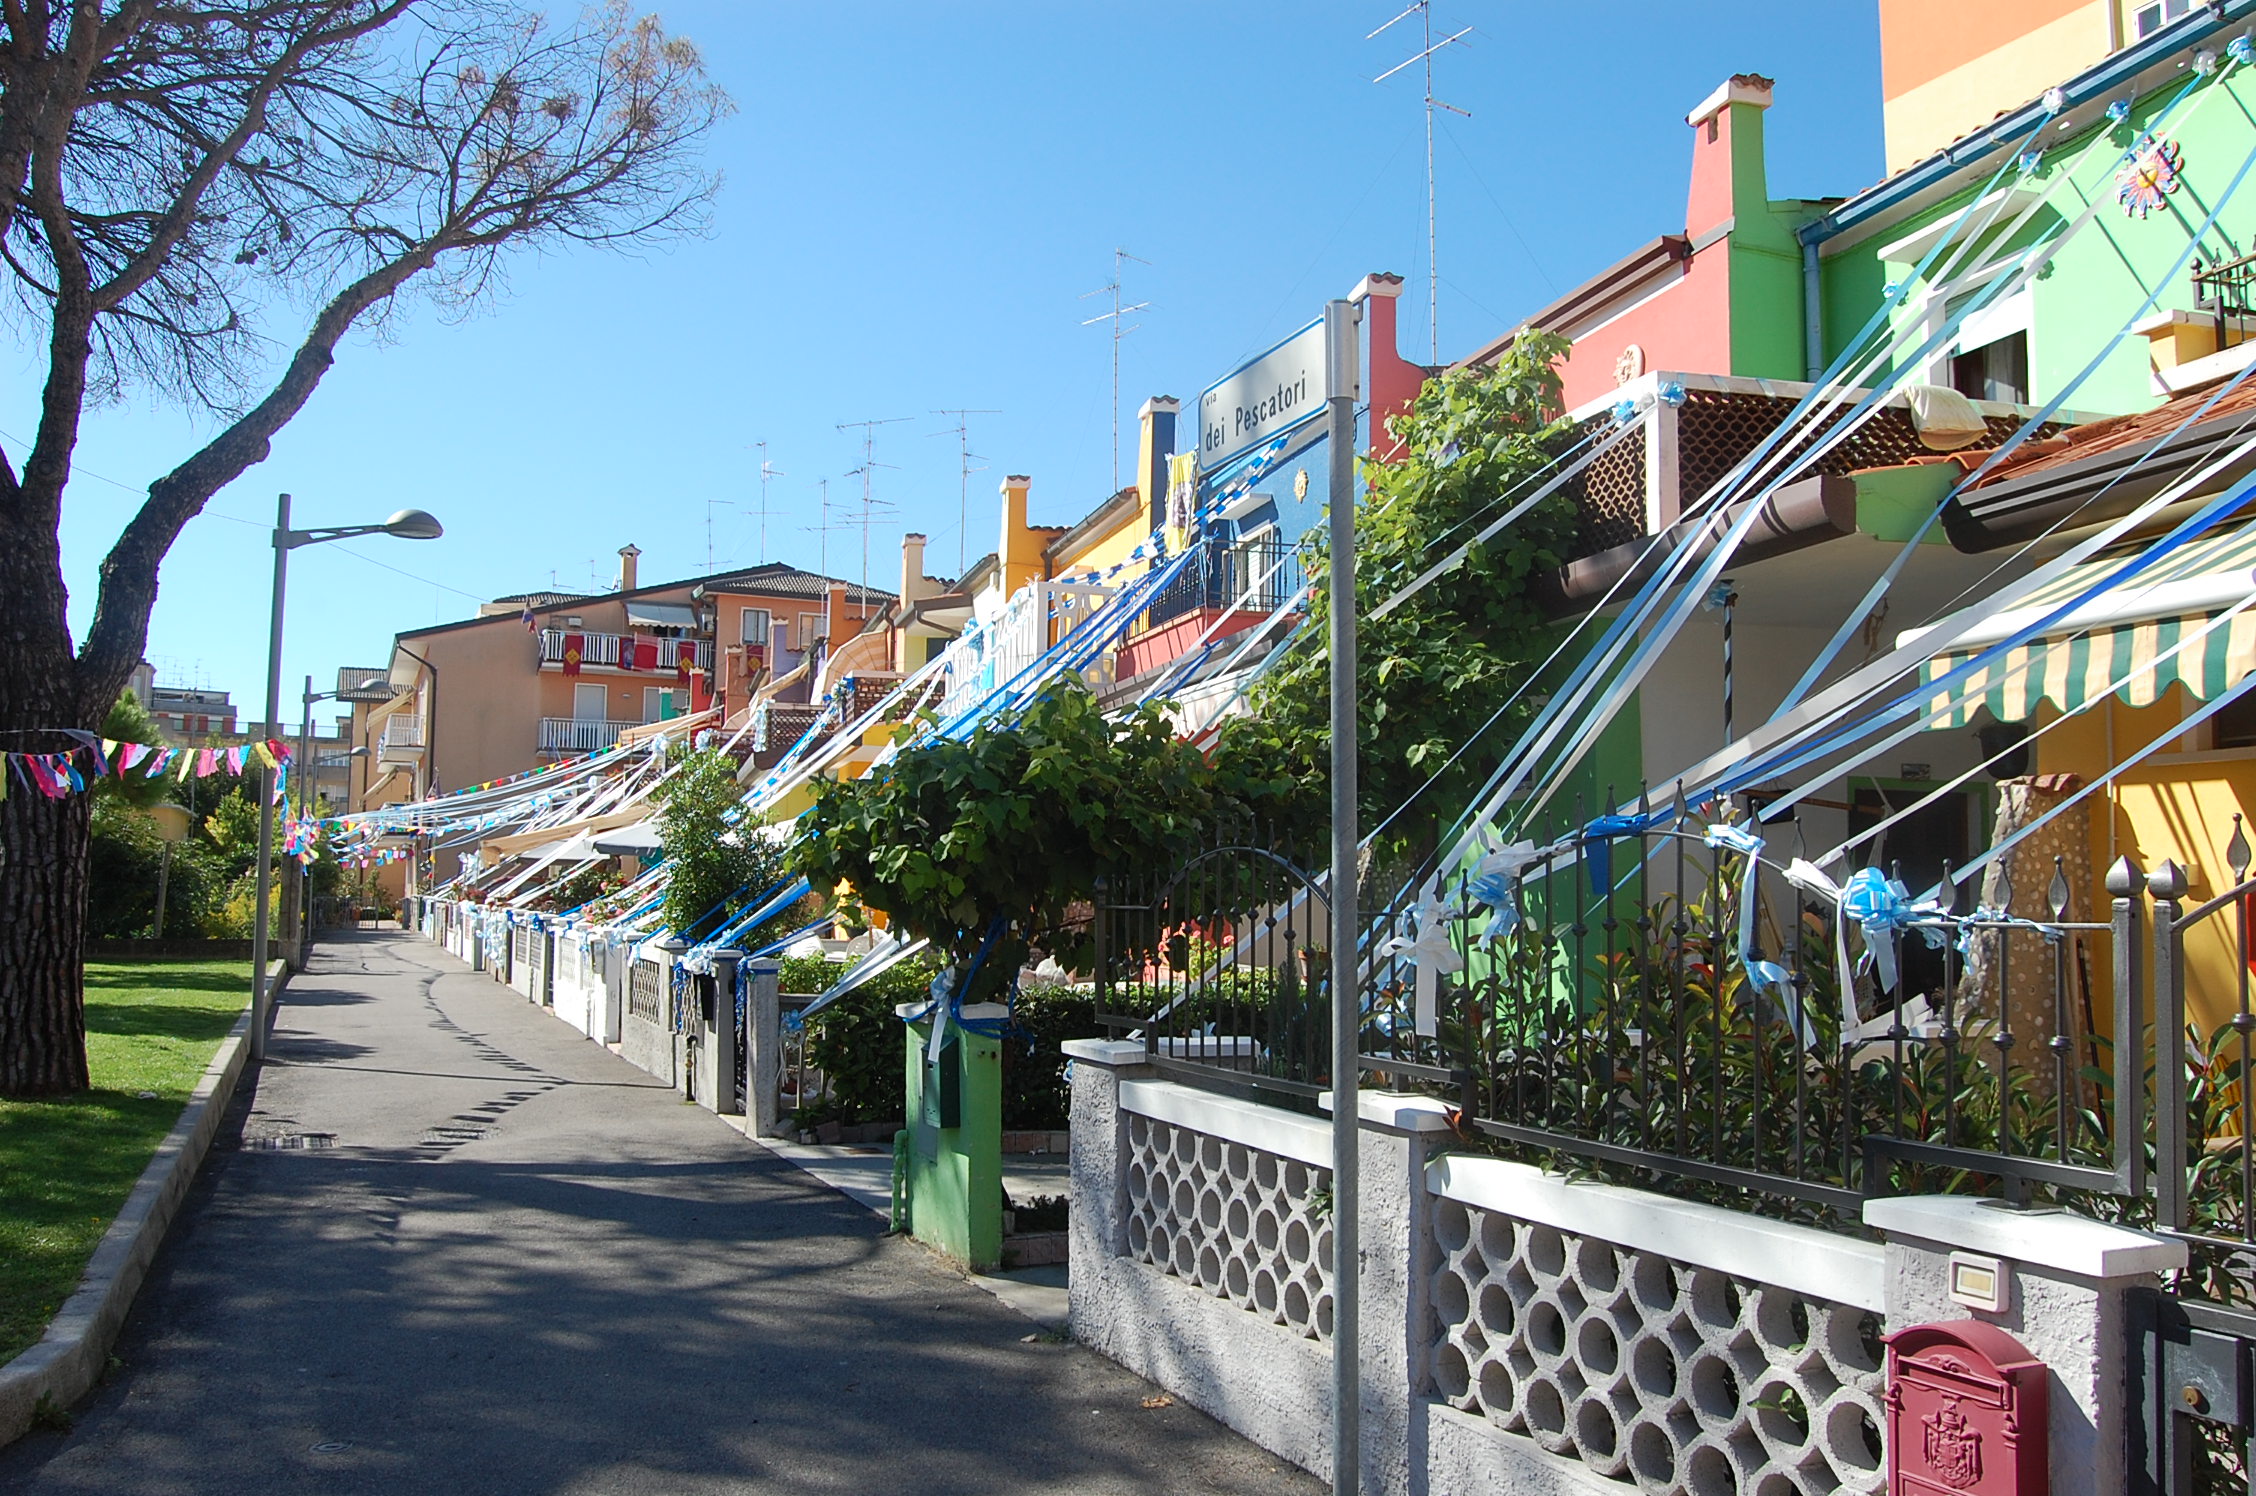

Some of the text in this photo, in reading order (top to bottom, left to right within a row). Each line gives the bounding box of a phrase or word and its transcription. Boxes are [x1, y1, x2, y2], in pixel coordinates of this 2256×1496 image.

[1205, 391, 1217, 407] via
[1206, 369, 1306, 452] dei Pescatori
